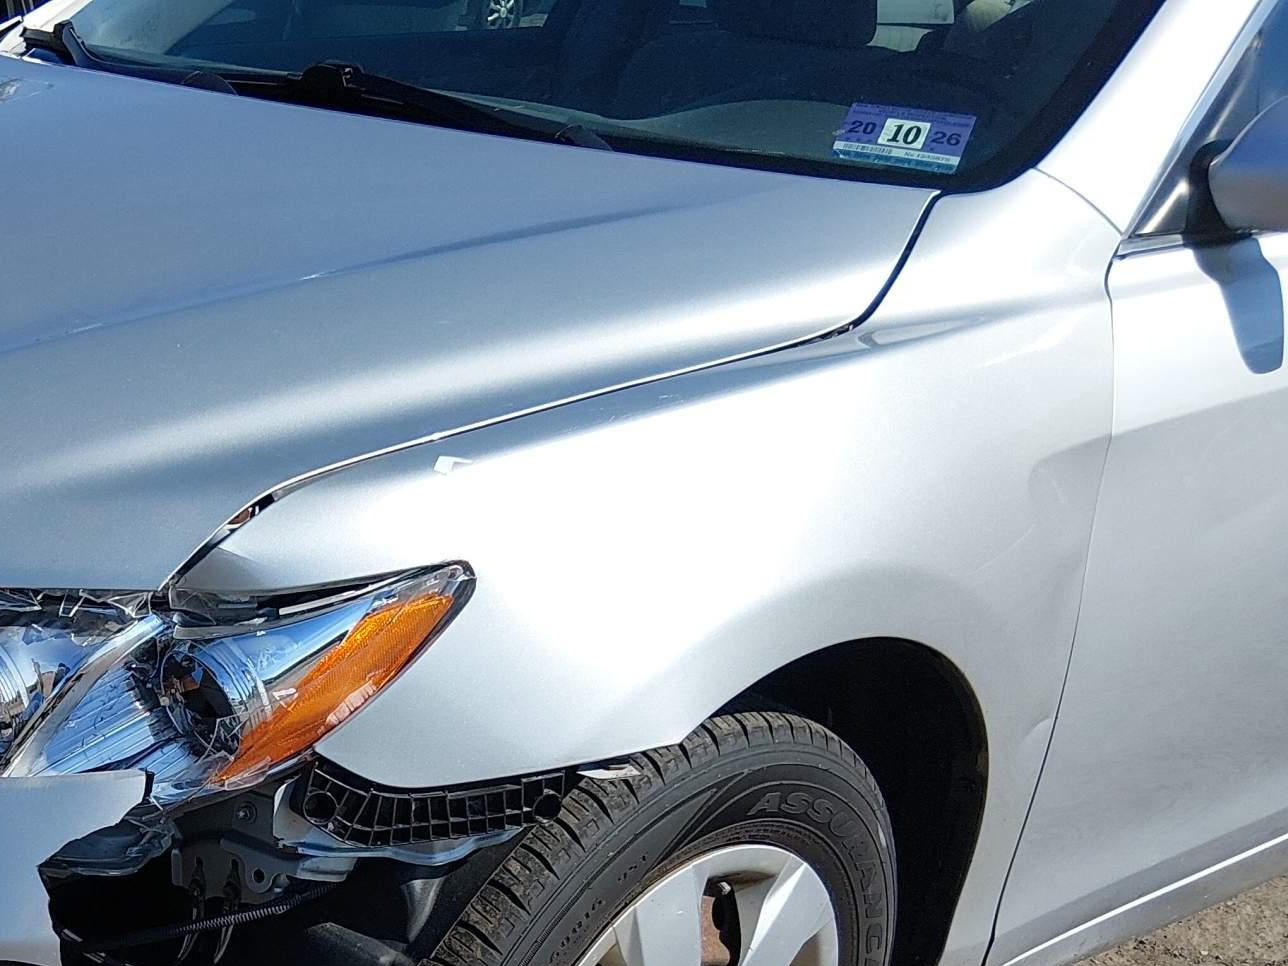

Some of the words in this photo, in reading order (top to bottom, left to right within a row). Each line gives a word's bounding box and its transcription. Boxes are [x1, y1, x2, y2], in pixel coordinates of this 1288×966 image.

[846, 119, 878, 136] 20
[886, 123, 922, 146] 10
[930, 130, 963, 147] 26
